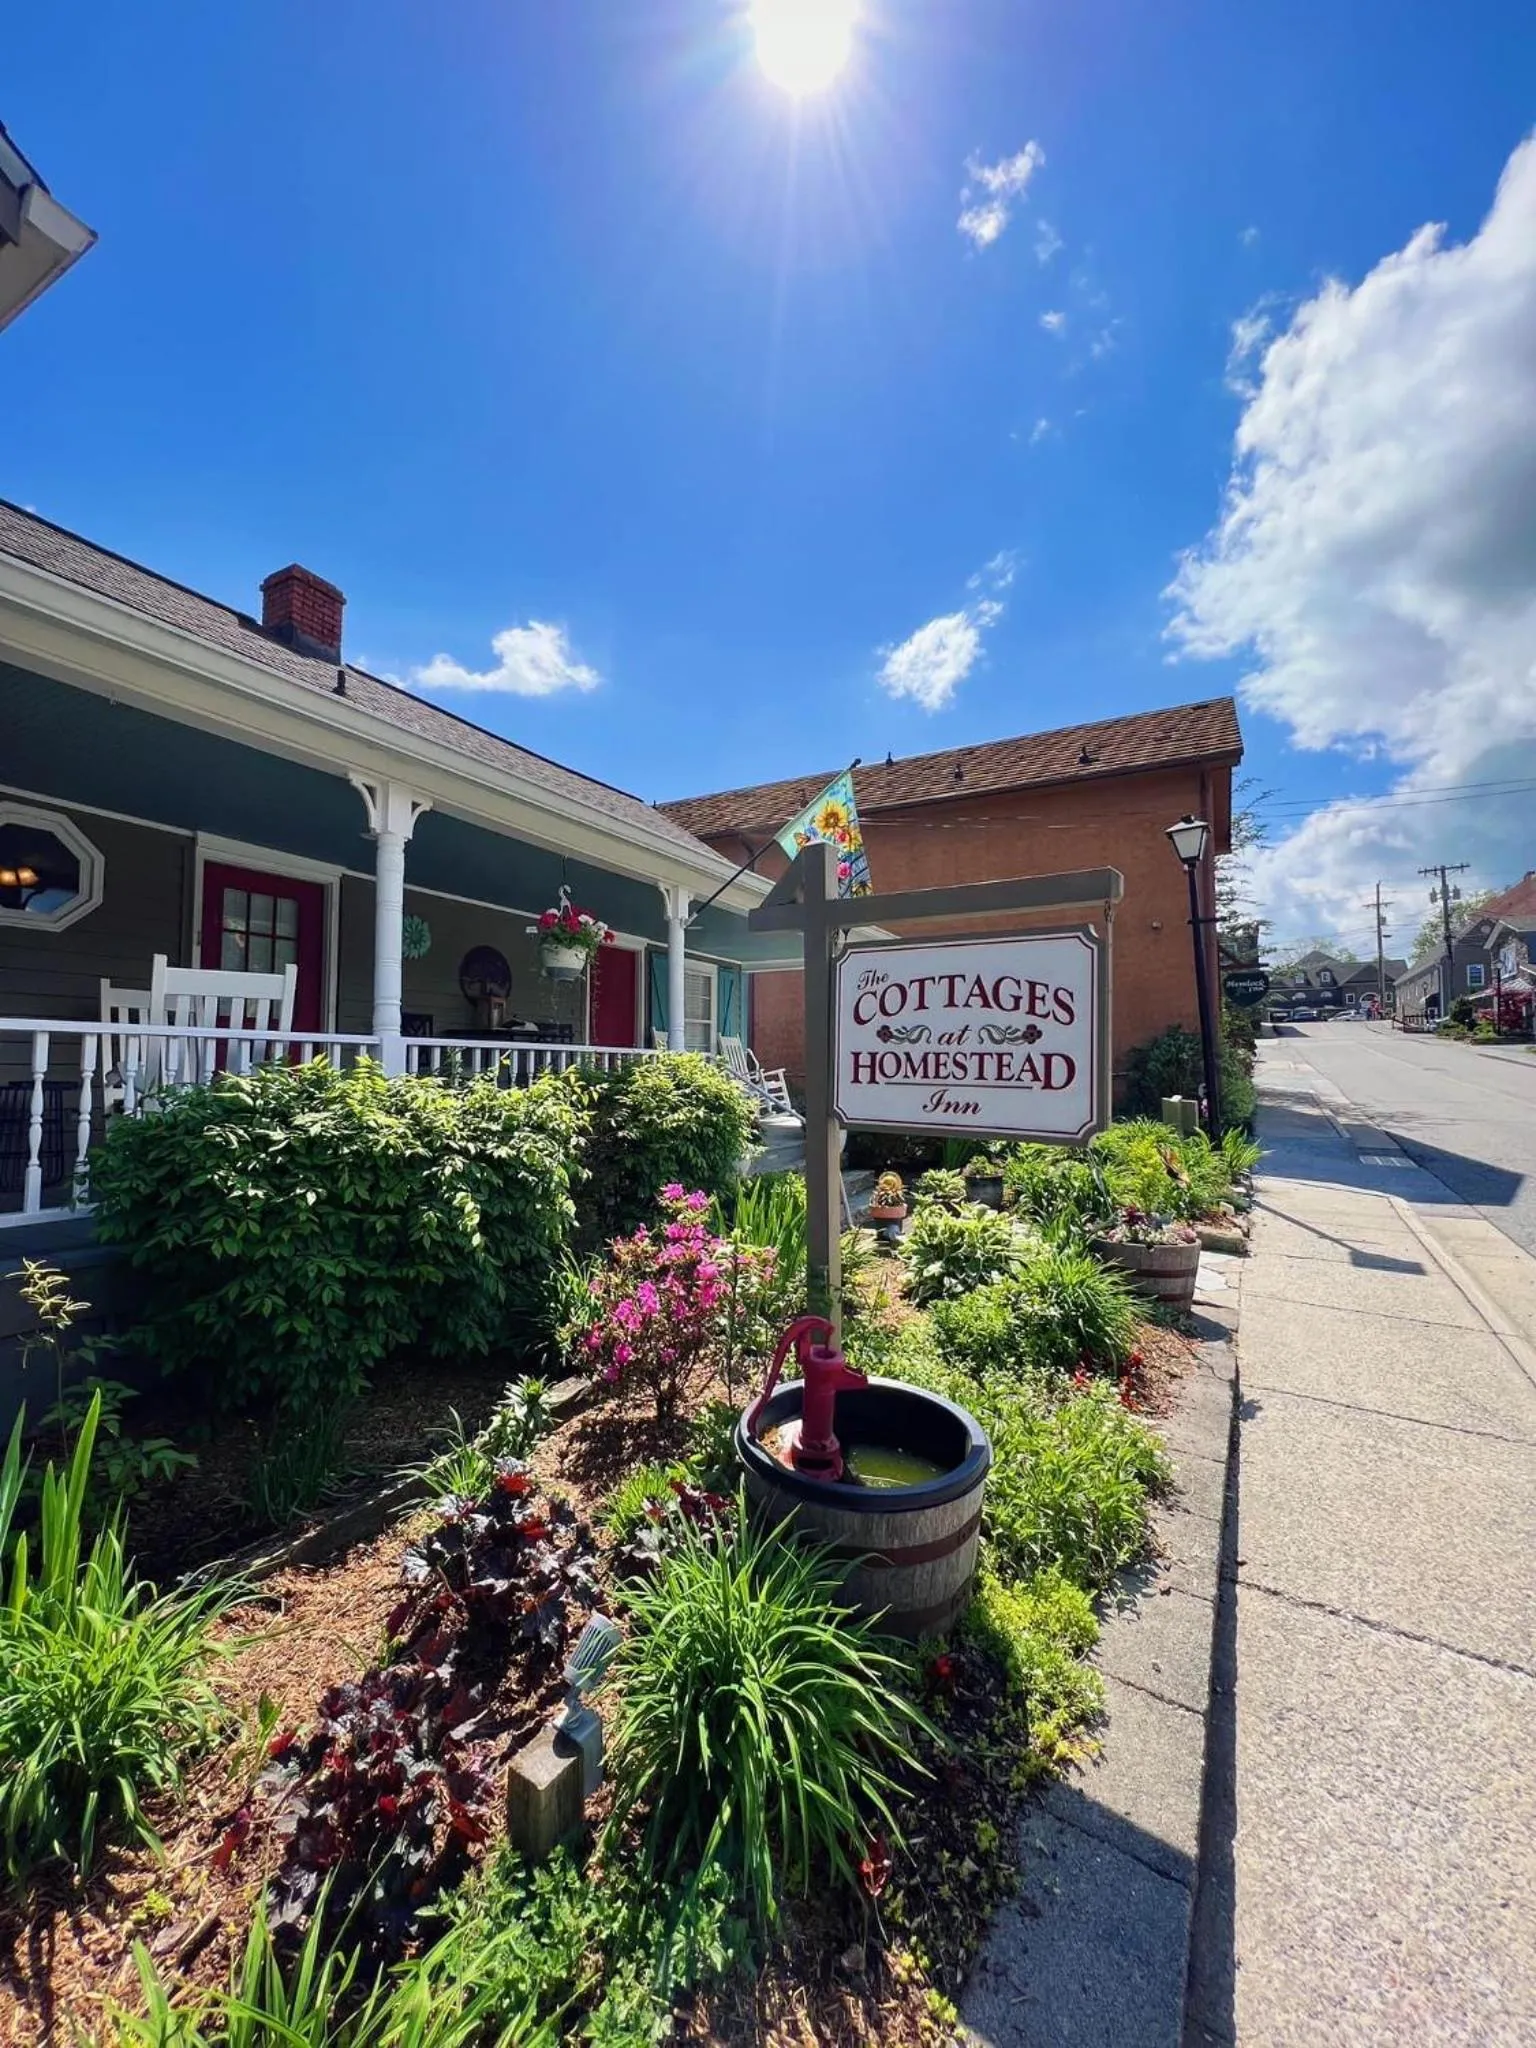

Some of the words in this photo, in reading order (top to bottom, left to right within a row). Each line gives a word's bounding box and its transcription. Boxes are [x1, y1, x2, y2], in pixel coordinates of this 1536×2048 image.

[857, 969, 890, 990] The
[853, 974, 1075, 1026] COTTAGES
[937, 1024, 971, 1046] at
[850, 1051, 1076, 1090] HOMESTEAD
[922, 1089, 982, 1115] Inn
